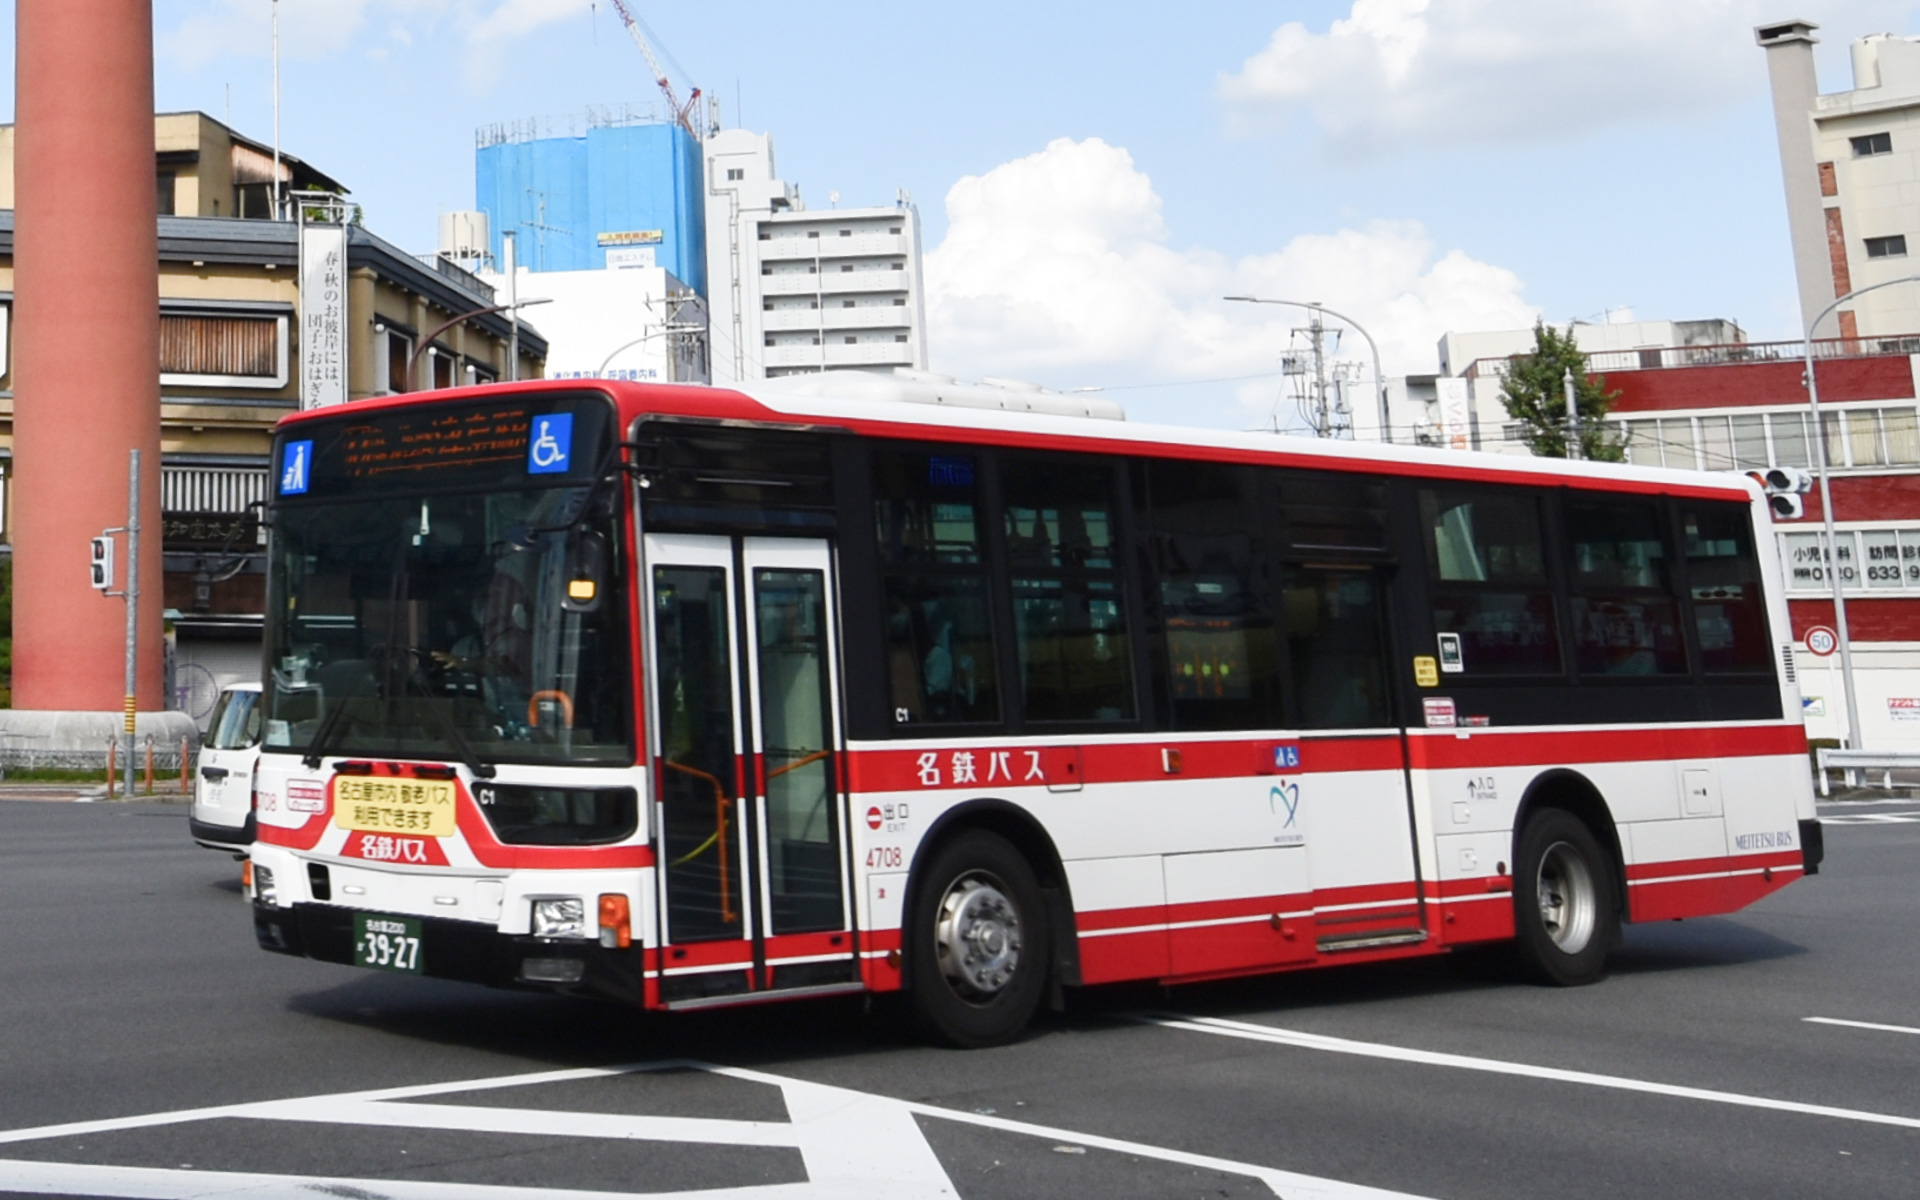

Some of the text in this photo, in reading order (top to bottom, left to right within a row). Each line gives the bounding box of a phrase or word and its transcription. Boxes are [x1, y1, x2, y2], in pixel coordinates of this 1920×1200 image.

[1869, 545, 1920, 560] 訪問診
[1812, 635, 1831, 649] 50
[895, 707, 909, 722] C1
[916, 751, 1044, 785] 名鉄バス
[340, 781, 396, 804] 名古屋市内
[401, 785, 449, 805] 敬老パス
[1478, 777, 1495, 790] 入口
[480, 789, 495, 805] C1
[354, 805, 433, 830] 利用できます
[884, 803, 909, 820] 出口
[887, 823, 906, 833] EXIT
[360, 834, 427, 862] 名鉄バス
[1735, 829, 1792, 850] MEITETSU BUS
[866, 846, 902, 868] 4708
[365, 932, 419, 970] 39-27
